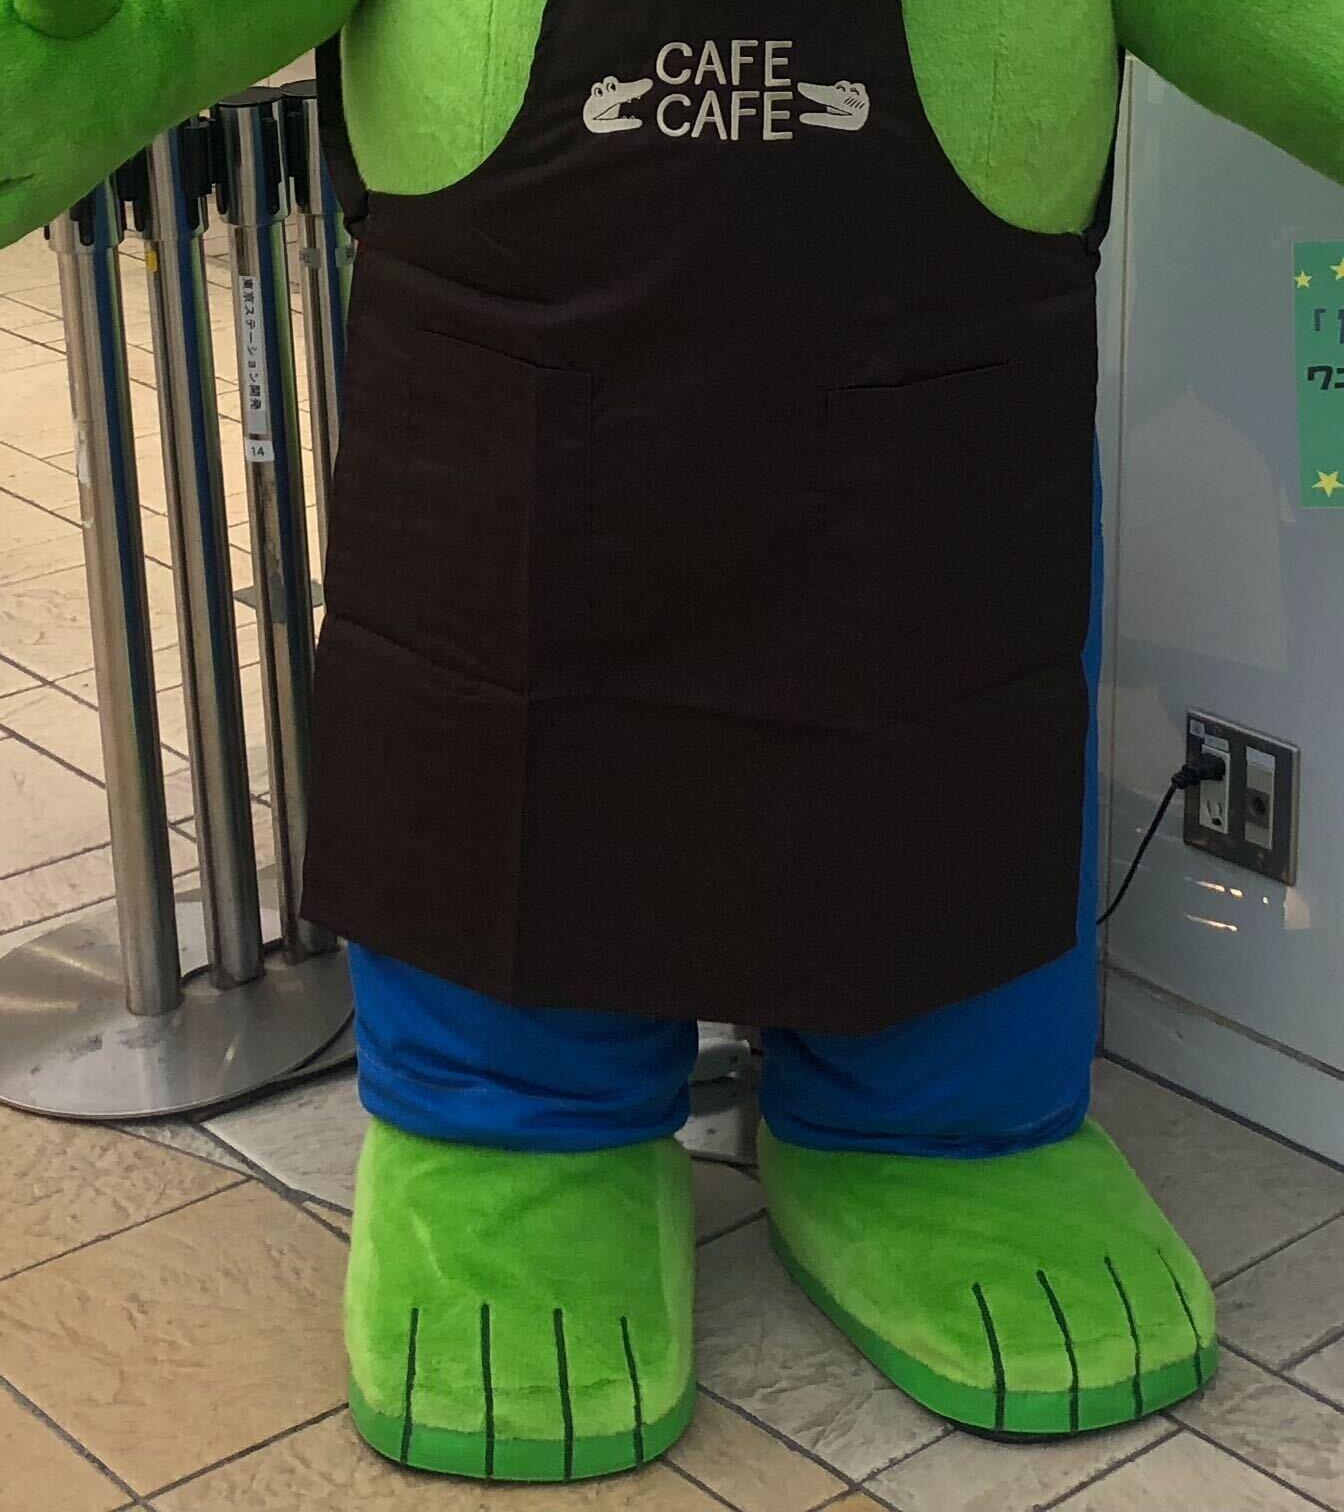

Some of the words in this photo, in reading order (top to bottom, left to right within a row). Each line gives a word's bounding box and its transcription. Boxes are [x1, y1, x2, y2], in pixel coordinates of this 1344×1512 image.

[656, 39, 793, 87] CAFE
[656, 90, 794, 141] CAFE
[250, 444, 265, 458] 14
